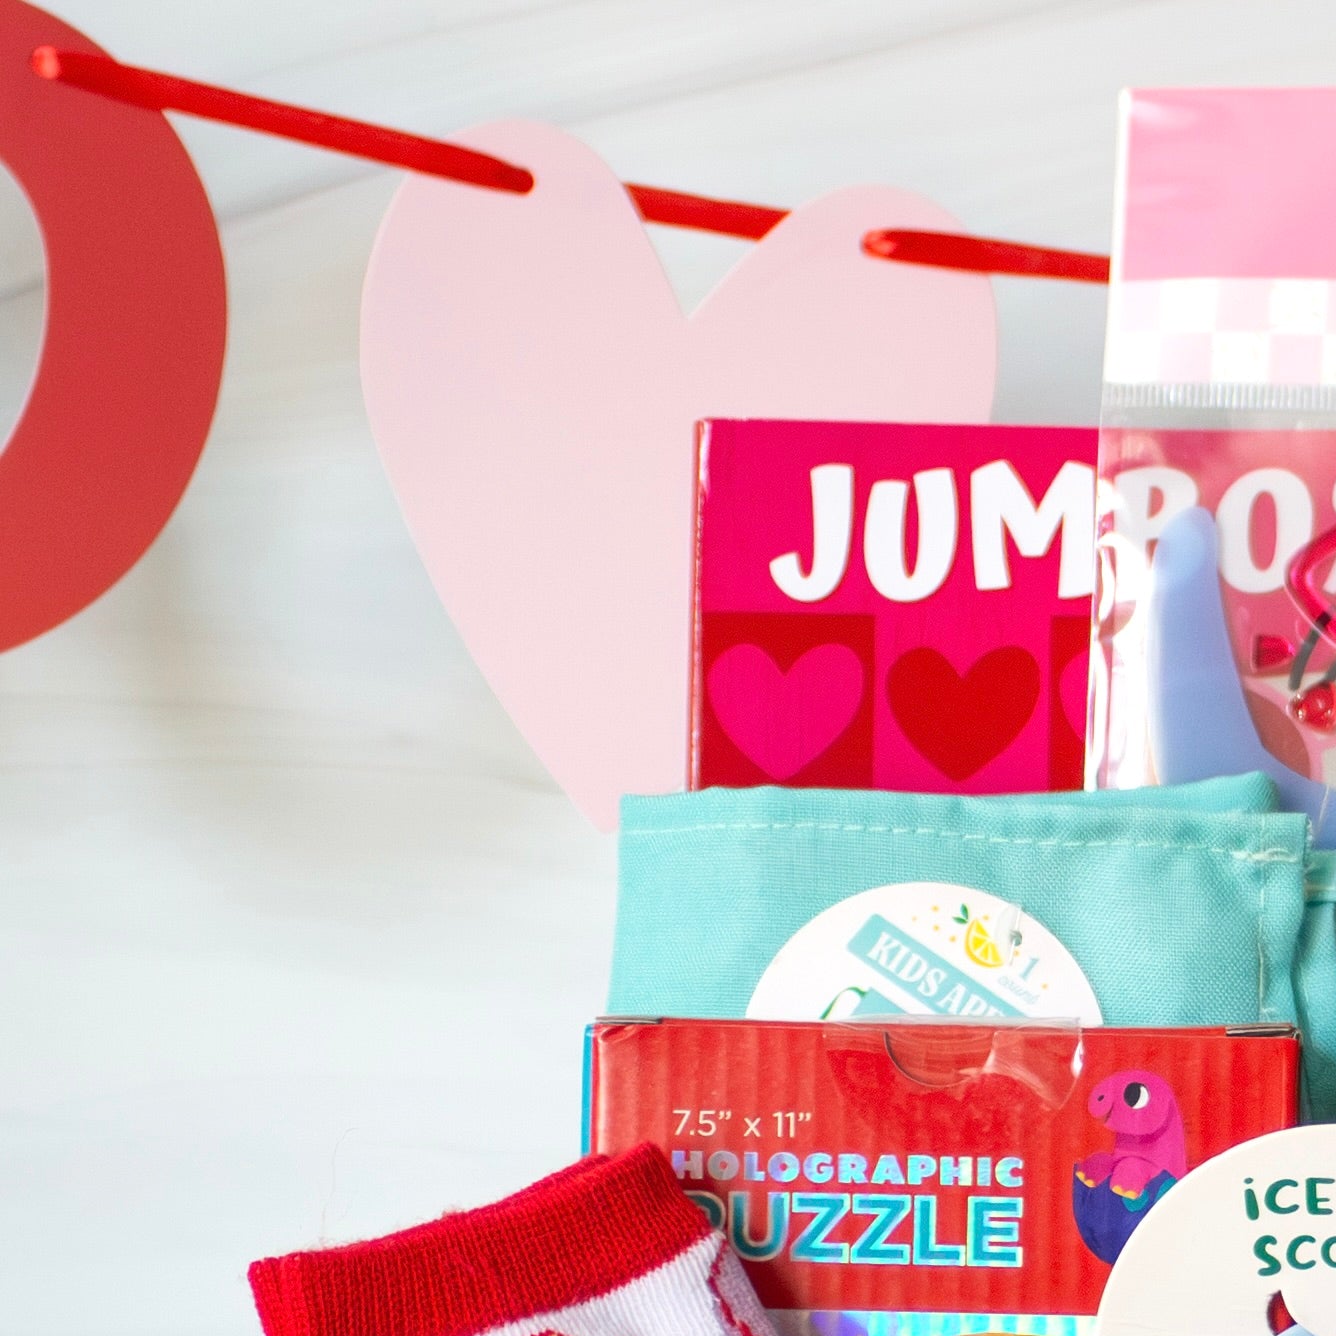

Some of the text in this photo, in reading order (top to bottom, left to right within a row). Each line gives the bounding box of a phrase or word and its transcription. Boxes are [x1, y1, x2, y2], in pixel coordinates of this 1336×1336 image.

[866, 931, 948, 998] KIDS
[1019, 957, 1041, 982] 1
[743, 1117, 761, 1138] x
[671, 1150, 1024, 1188] HOLOGRAPHIC
